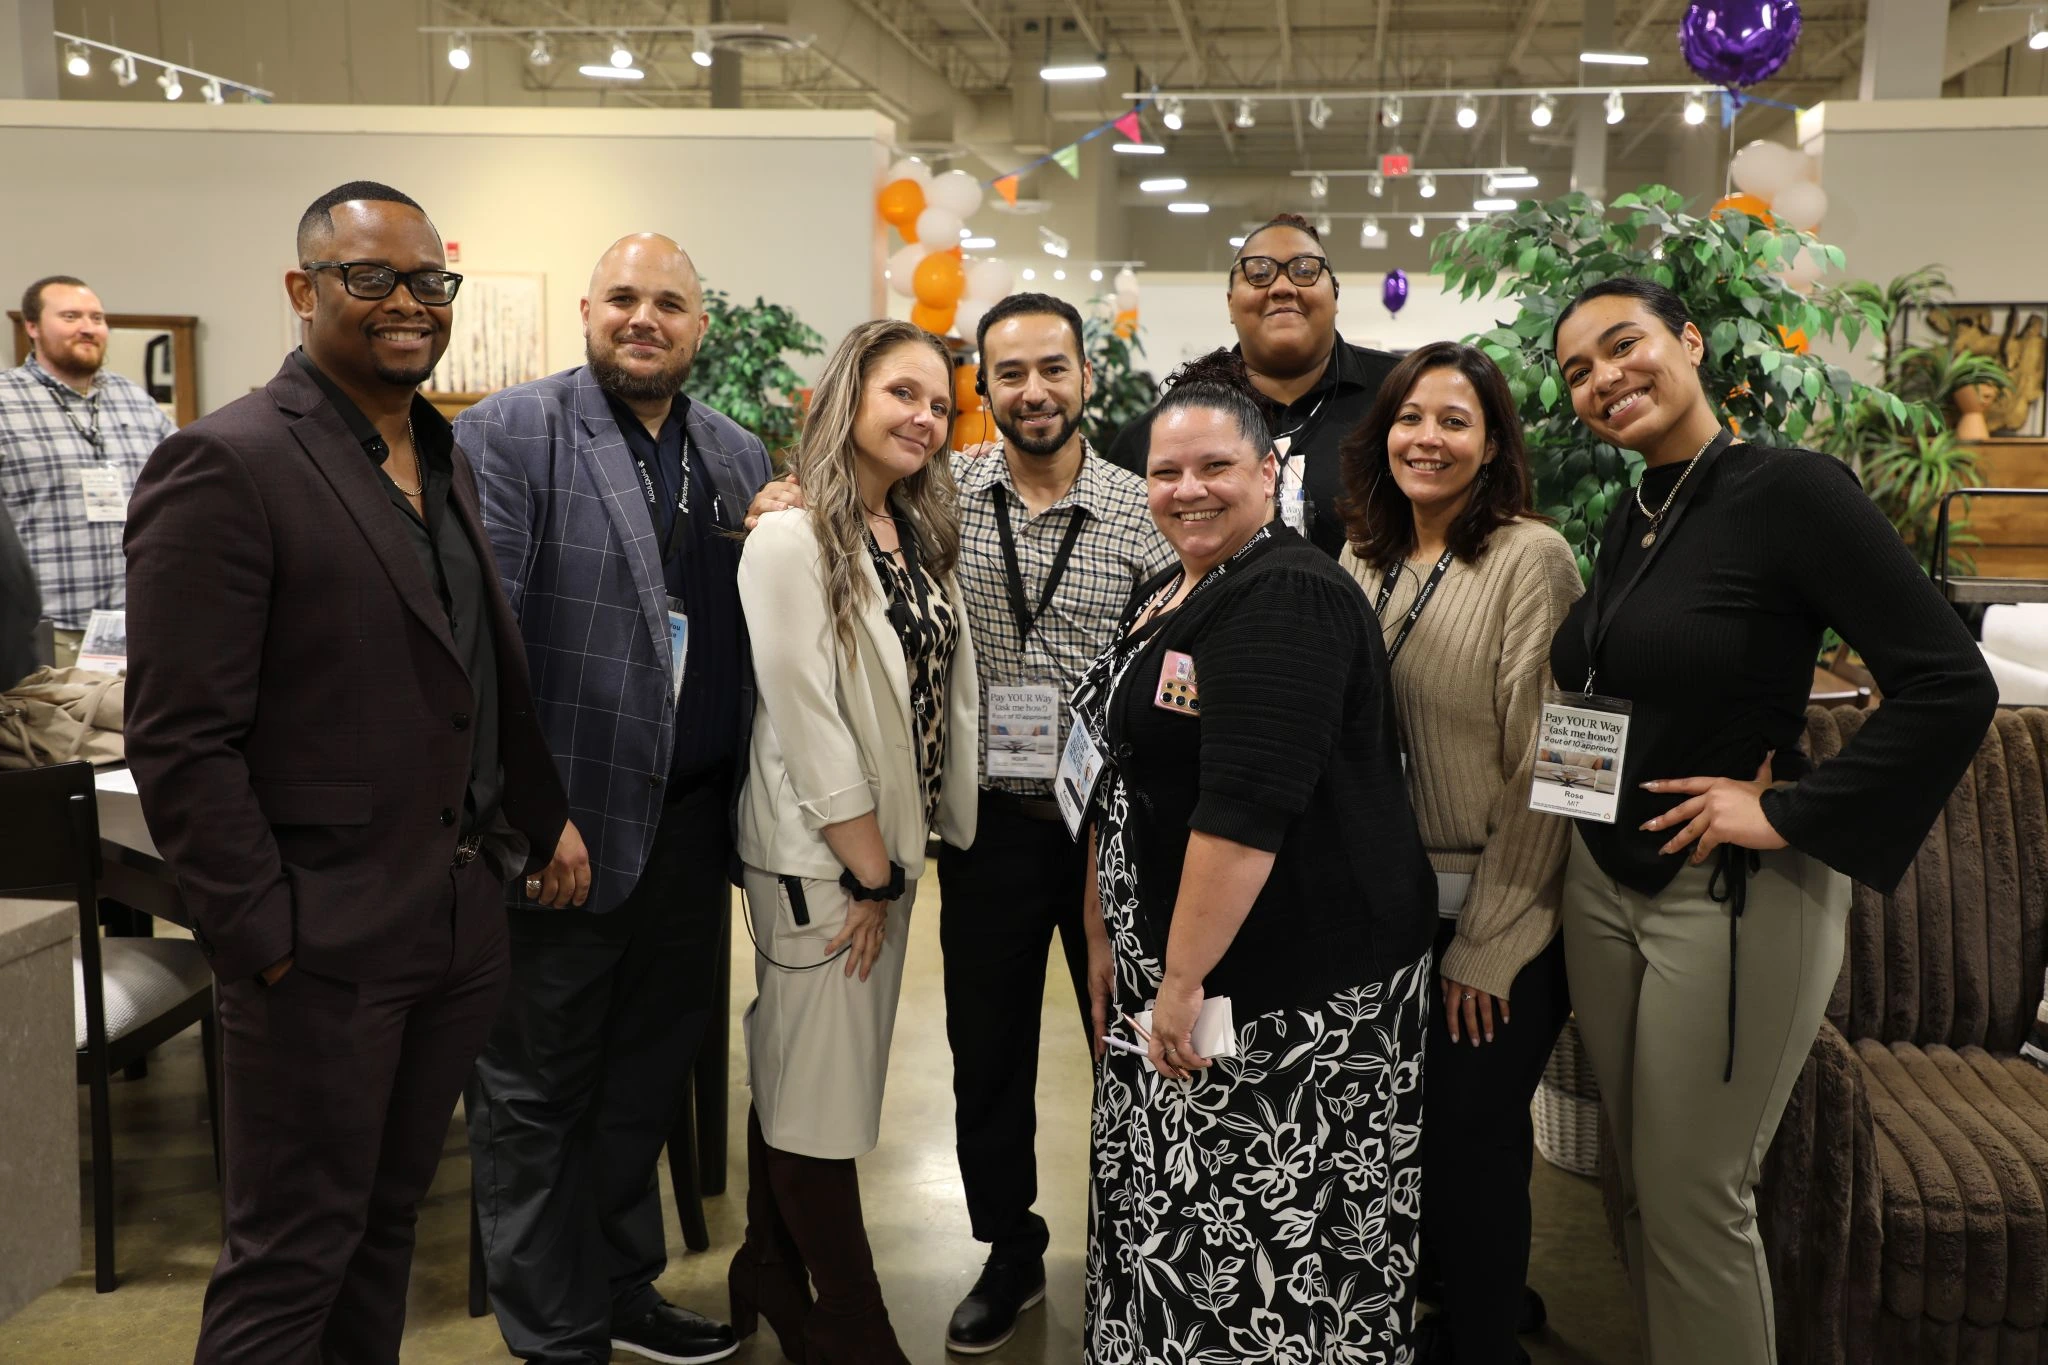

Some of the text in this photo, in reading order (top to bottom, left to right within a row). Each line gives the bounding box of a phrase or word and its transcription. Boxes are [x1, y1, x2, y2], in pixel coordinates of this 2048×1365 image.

[640, 468, 656, 503] synchrony
[1232, 531, 1264, 560] synchrony
[1414, 582, 1434, 612] synchrony
[990, 693, 1053, 704] Pay YOUR Way
[1545, 712, 1623, 735] Pay YOUR Way
[1549, 725, 1615, 745] (ask me how!)
[1572, 740, 1580, 748] 10
[1580, 743, 1618, 754] approved
[1564, 790, 1584, 800] Rose
